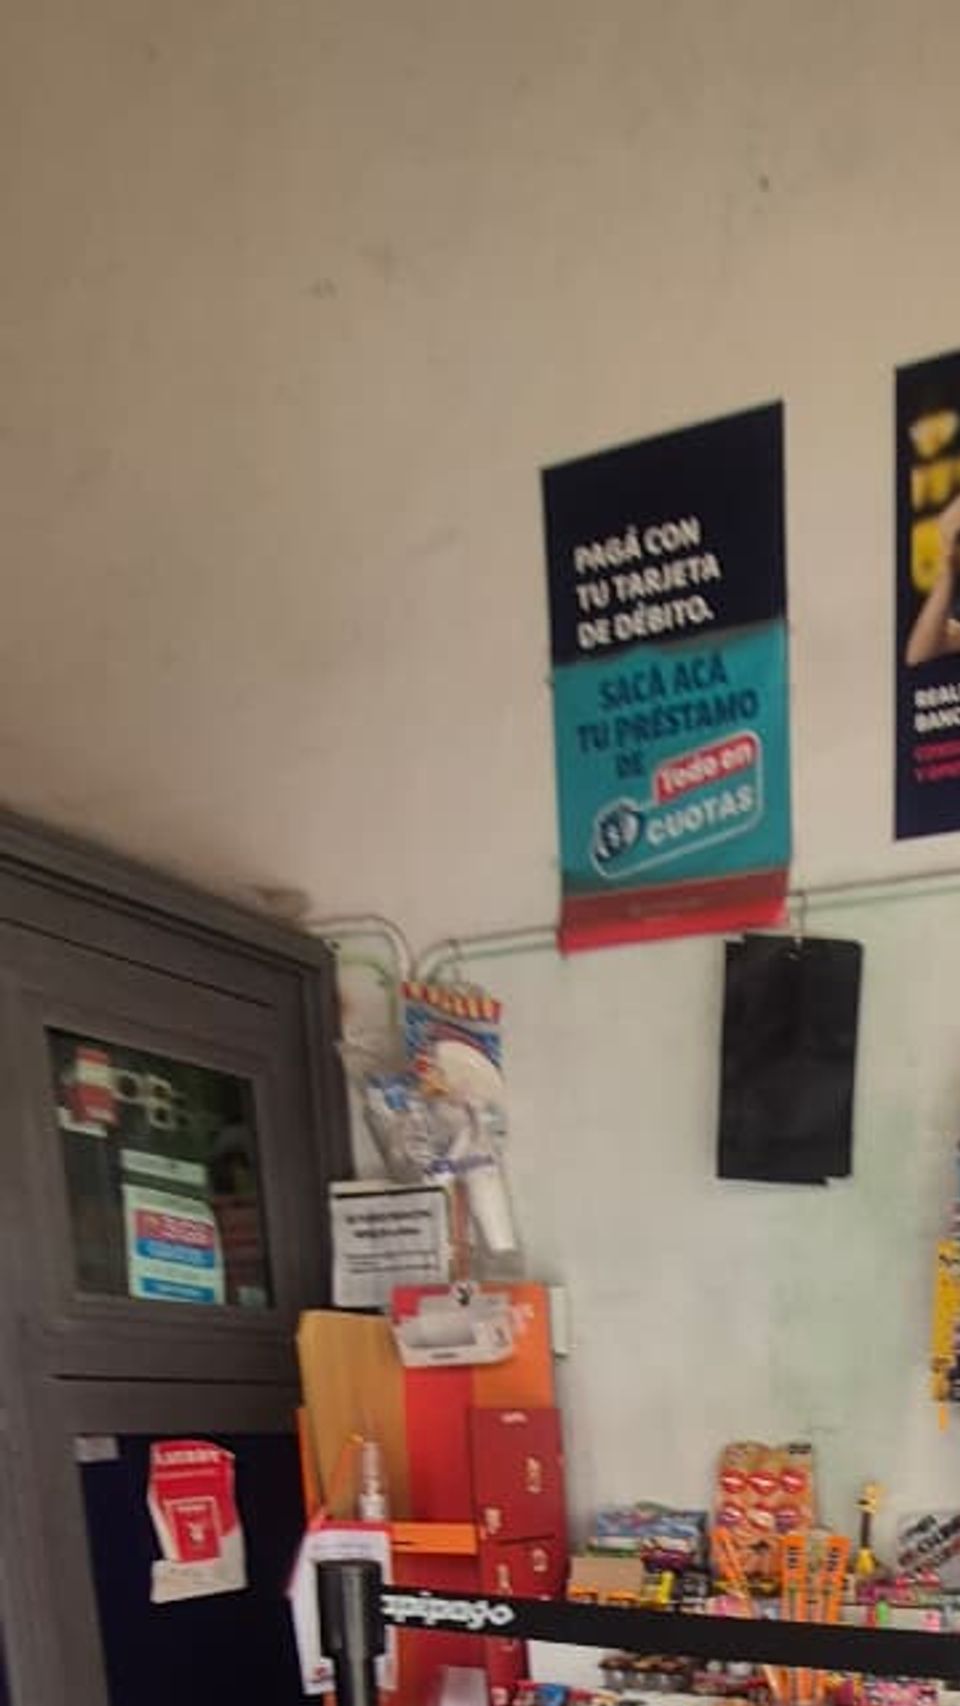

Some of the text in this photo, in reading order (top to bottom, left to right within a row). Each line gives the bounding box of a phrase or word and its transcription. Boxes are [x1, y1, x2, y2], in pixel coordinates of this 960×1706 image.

[573, 516, 701, 575] PAGÁ CON
[576, 552, 721, 613] TU TARJETA
[577, 618, 611, 649] DE
[578, 721, 610, 754] TU
[646, 784, 754, 845] CUOTAS
[379, 1590, 516, 1630] apipago
